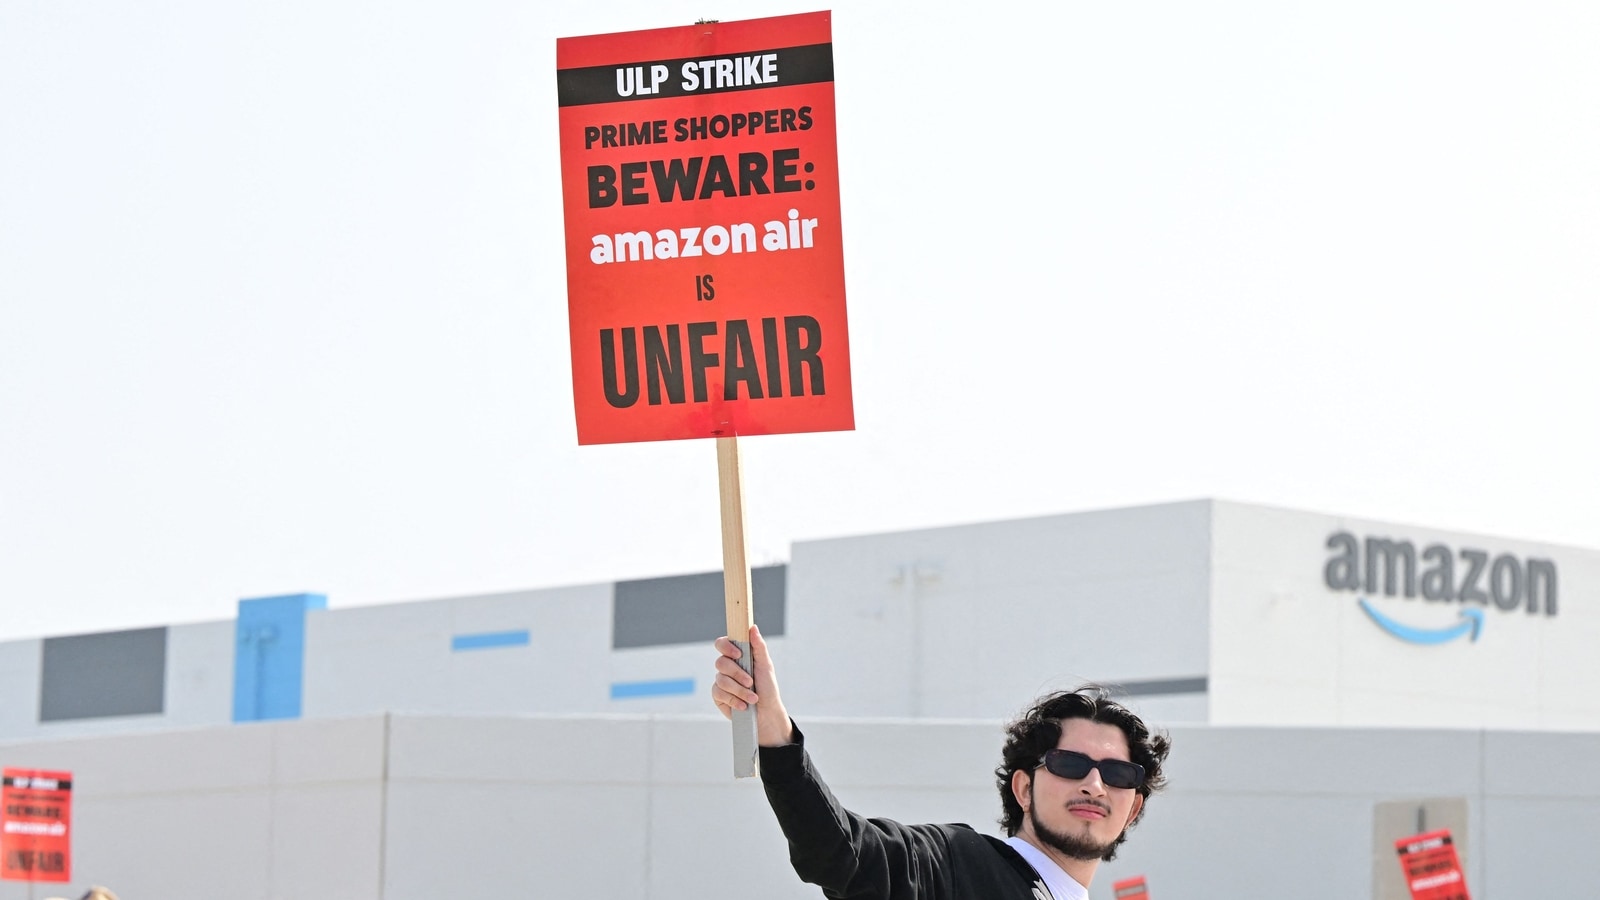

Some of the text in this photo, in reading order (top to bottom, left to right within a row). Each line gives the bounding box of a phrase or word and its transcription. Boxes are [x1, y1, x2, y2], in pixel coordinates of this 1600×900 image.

[616, 53, 778, 97] ULP STRIKE
[584, 106, 813, 150] PRIME SHOPPERS
[587, 148, 815, 209] BEWARE:
[590, 209, 818, 265] amazon air
[696, 274, 715, 302] IS
[599, 315, 826, 409] UNFAIR
[1323, 530, 1558, 617] amazon
